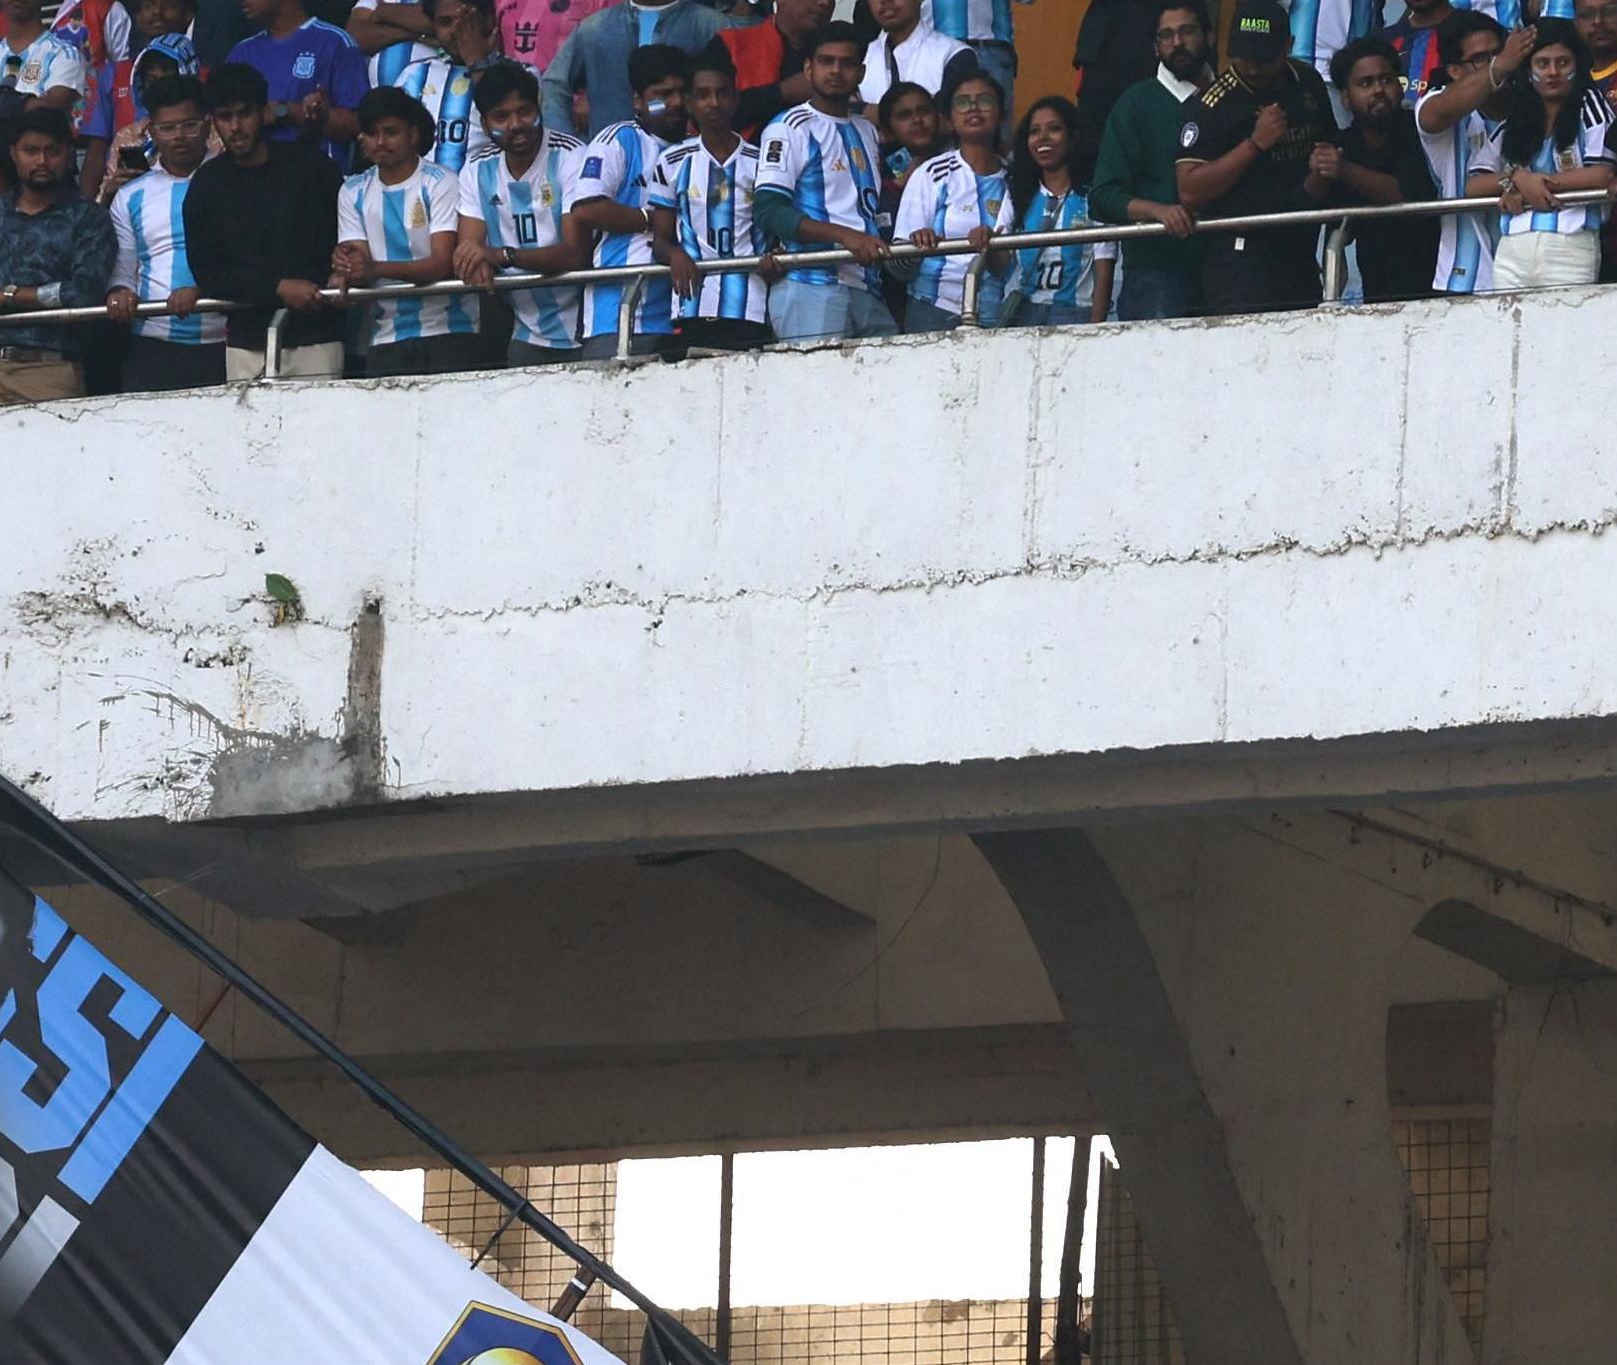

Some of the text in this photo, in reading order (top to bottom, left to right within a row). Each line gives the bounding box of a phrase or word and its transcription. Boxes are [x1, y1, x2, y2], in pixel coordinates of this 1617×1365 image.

[437, 119, 469, 144] 10
[513, 213, 538, 243] 10
[1037, 261, 1063, 290] 10
